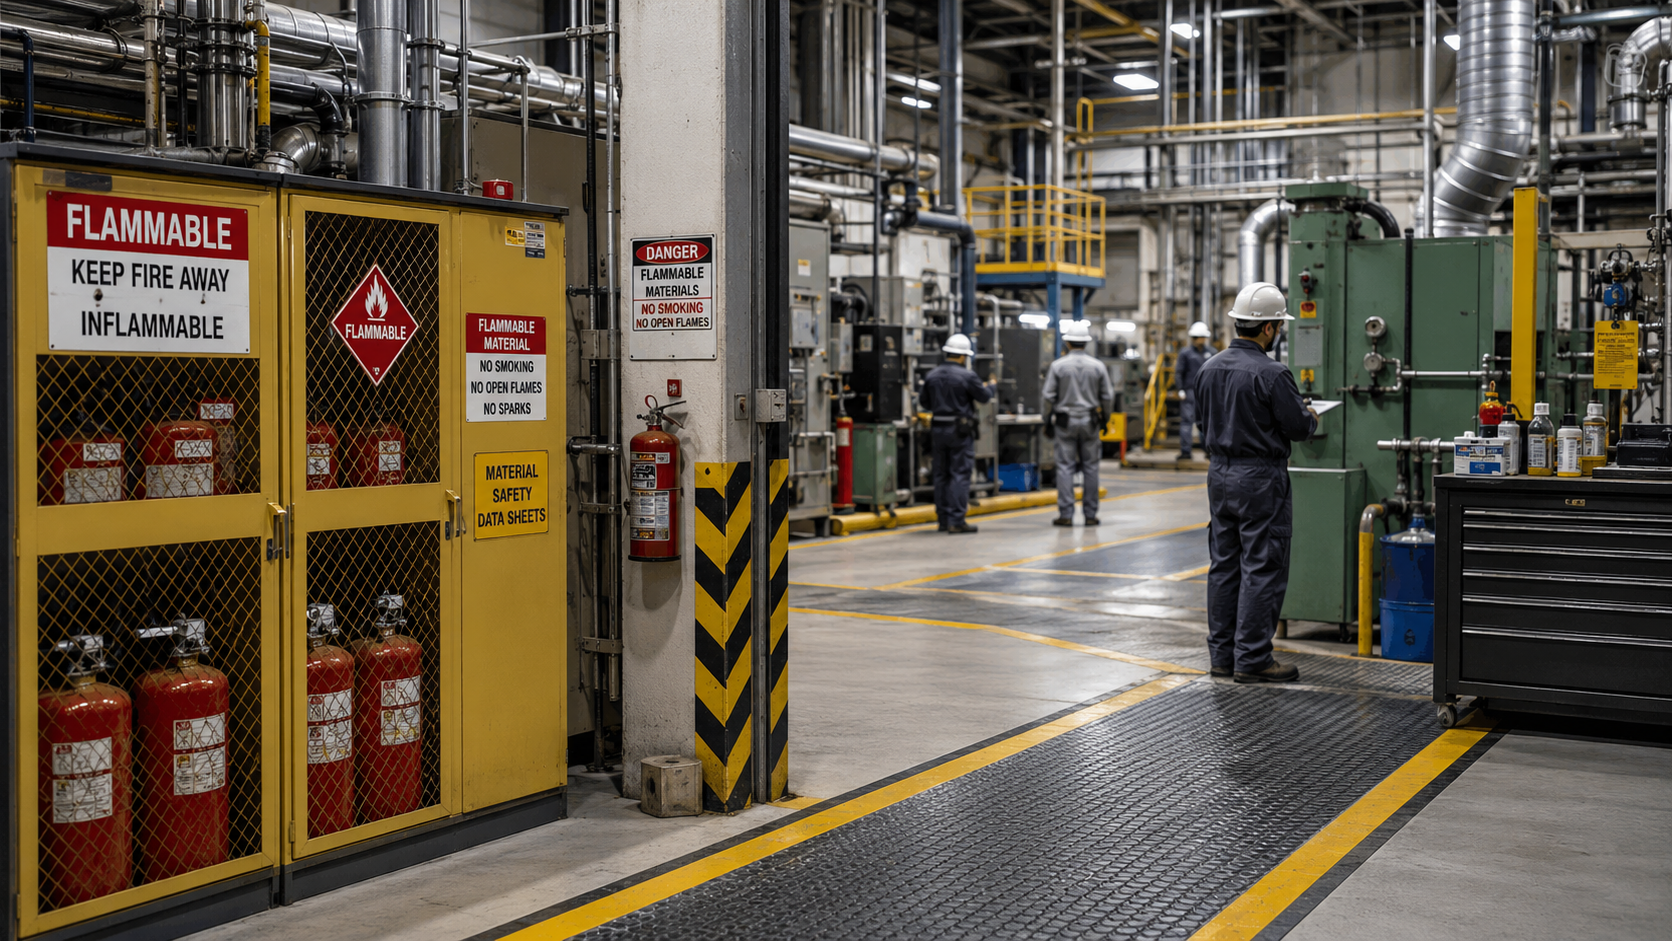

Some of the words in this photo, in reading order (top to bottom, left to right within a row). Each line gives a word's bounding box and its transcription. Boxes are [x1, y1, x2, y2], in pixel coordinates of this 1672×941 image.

[66, 203, 232, 250] FLAMMABLE
[646, 245, 699, 260] DANGER
[71, 258, 125, 287] KEEP
[131, 262, 174, 290] FIRE
[179, 266, 230, 293] AWAY
[640, 267, 704, 281] FLAMMABLE
[645, 284, 700, 298] MATERIALS
[641, 304, 655, 314] NO
[657, 302, 704, 314] SMOKING
[81, 310, 224, 340] INFLAMMABLE
[478, 318, 535, 334] FLAMMABLE
[636, 318, 648, 328] NO
[650, 317, 674, 328] OPEN
[676, 317, 709, 328] FLAMES
[345, 323, 407, 341] FLAMMABLE
[483, 336, 531, 351] MATERIAL
[480, 360, 493, 373] NO
[494, 359, 534, 373] SMOKING
[470, 381, 484, 394] NO
[485, 381, 509, 394] OPEN
[510, 381, 543, 394] FLAMES
[483, 403, 496, 415] NO
[498, 402, 532, 415] SPARKS
[485, 463, 539, 481] MATERIAL
[492, 486, 533, 503] SAFETY
[477, 511, 505, 528] DATA
[507, 507, 546, 525] SHEETS
